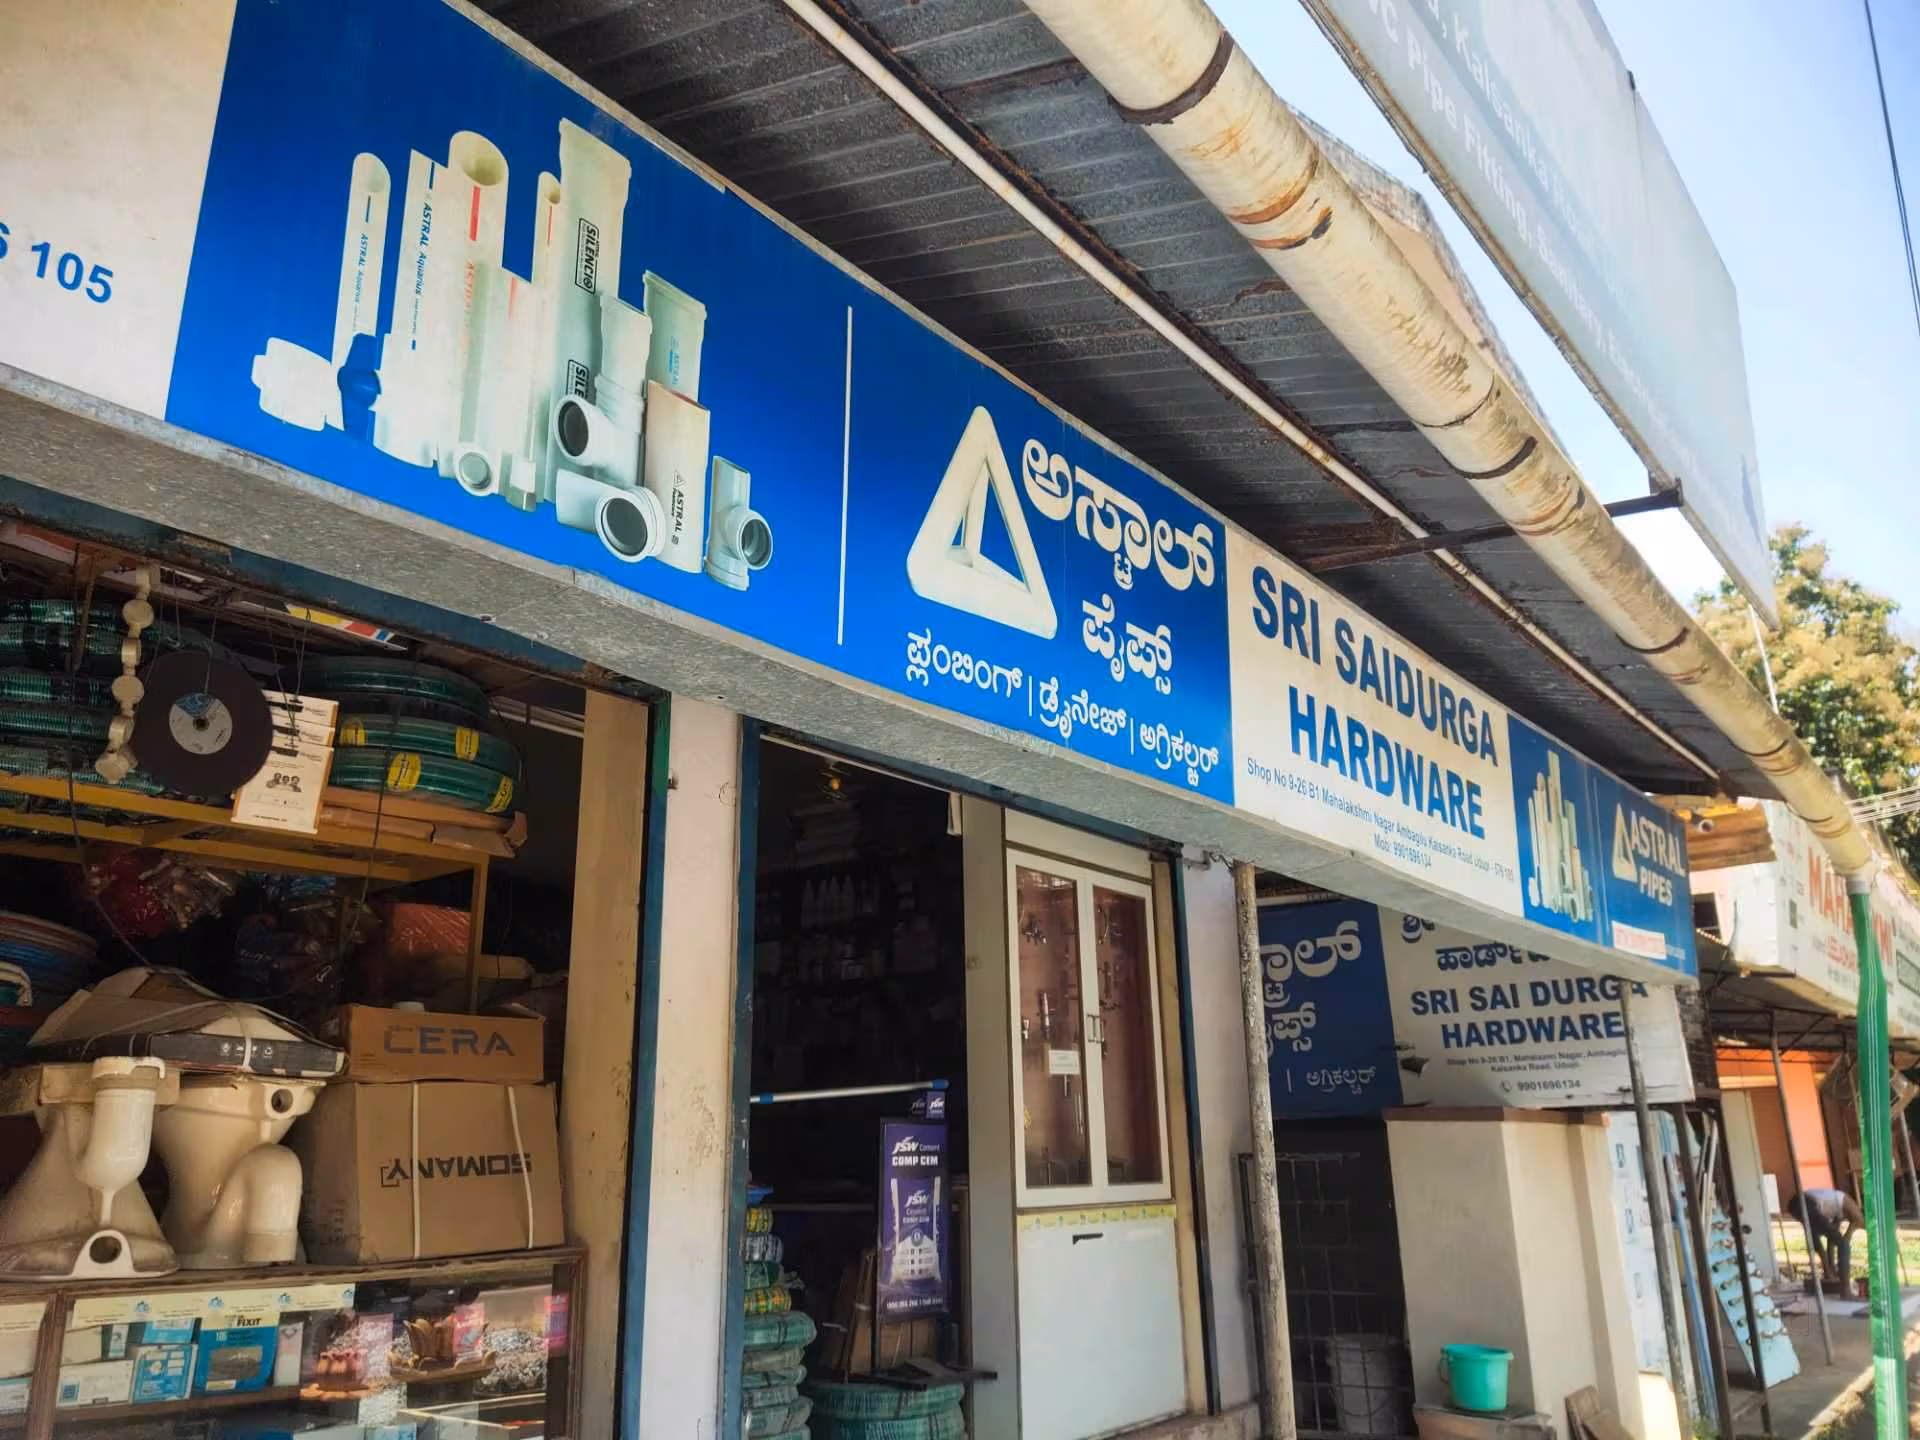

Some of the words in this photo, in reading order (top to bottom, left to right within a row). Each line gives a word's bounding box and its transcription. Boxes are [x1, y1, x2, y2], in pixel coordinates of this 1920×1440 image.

[418, 202, 433, 248] ASTRAL
[31, 241, 114, 304] 105
[415, 252, 427, 296] Aquarius
[675, 489, 685, 532] ASTRAL
[906, 627, 1023, 698] ಪ್ಲಂಬಿಂಗ್
[1252, 565, 1320, 665] SRI
[1335, 617, 1498, 767] SAIDURGA
[1247, 758, 1272, 784] Shop
[1274, 768, 1287, 787] No
[1288, 685, 1485, 840] HARDWARE
[1631, 810, 1686, 878] ASTRAL
[1640, 866, 1672, 907] PIPES
[1411, 987, 1459, 1016] SRI
[1469, 983, 1520, 1012] SAI
[383, 1026, 516, 1057] CERA
[1441, 1011, 1627, 1049] HARDWARE
[386, 1153, 533, 1181] SOMANY
[892, 1155, 919, 1167] COMP
